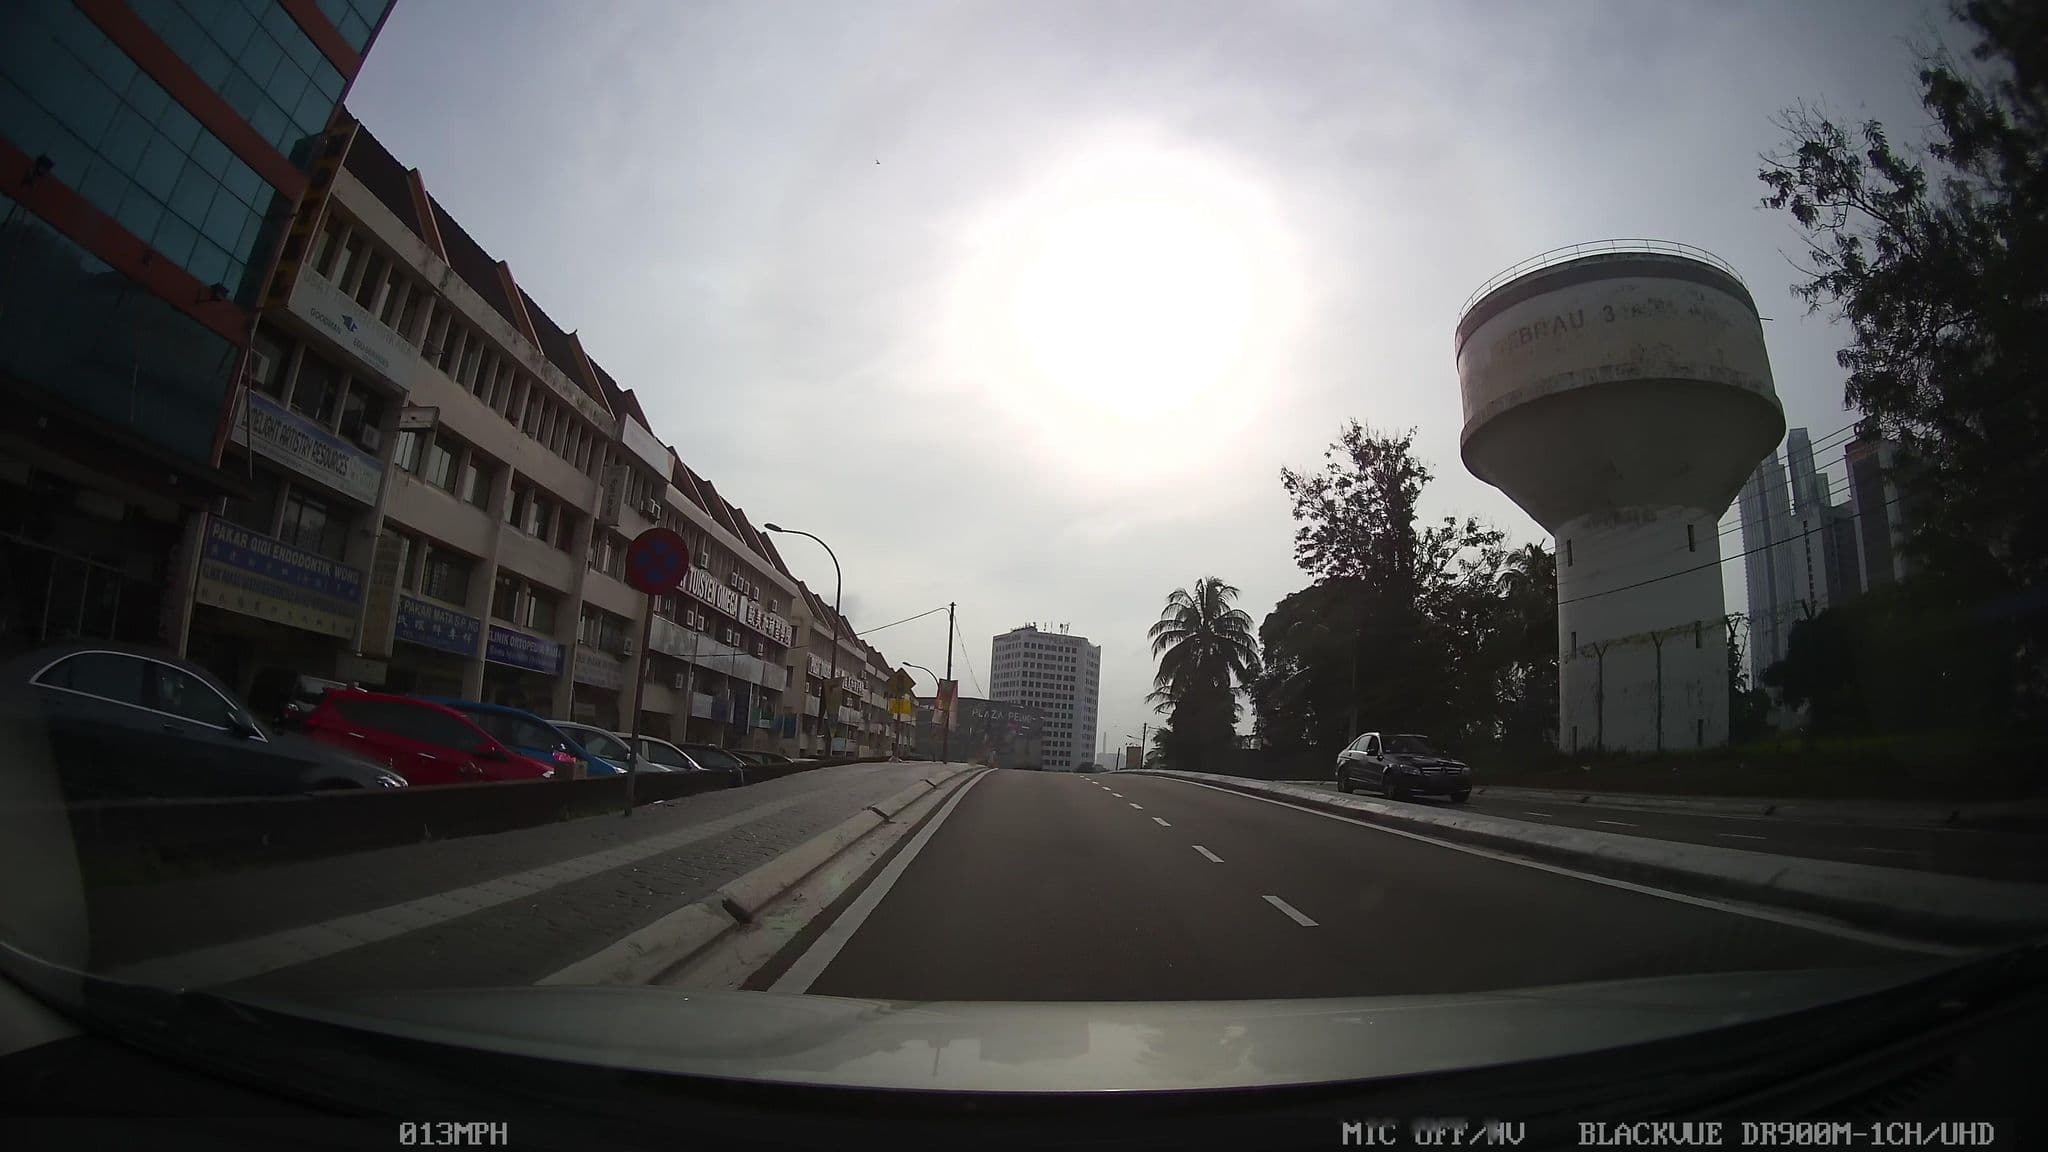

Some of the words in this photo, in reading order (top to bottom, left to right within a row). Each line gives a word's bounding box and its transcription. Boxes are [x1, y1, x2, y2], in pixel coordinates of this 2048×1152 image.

[1601, 304, 1616, 323] 3
[280, 424, 313, 460] ARTISTRY
[311, 439, 350, 477] RESOURCES
[212, 523, 248, 549] PAKAR
[272, 545, 332, 577] ENDODONTIK
[404, 598, 431, 619] PAKAR
[433, 607, 454, 626] MATA
[688, 567, 717, 606] TUISYEN
[717, 584, 739, 618] OMEGA
[971, 708, 1004, 720] PLAZA
